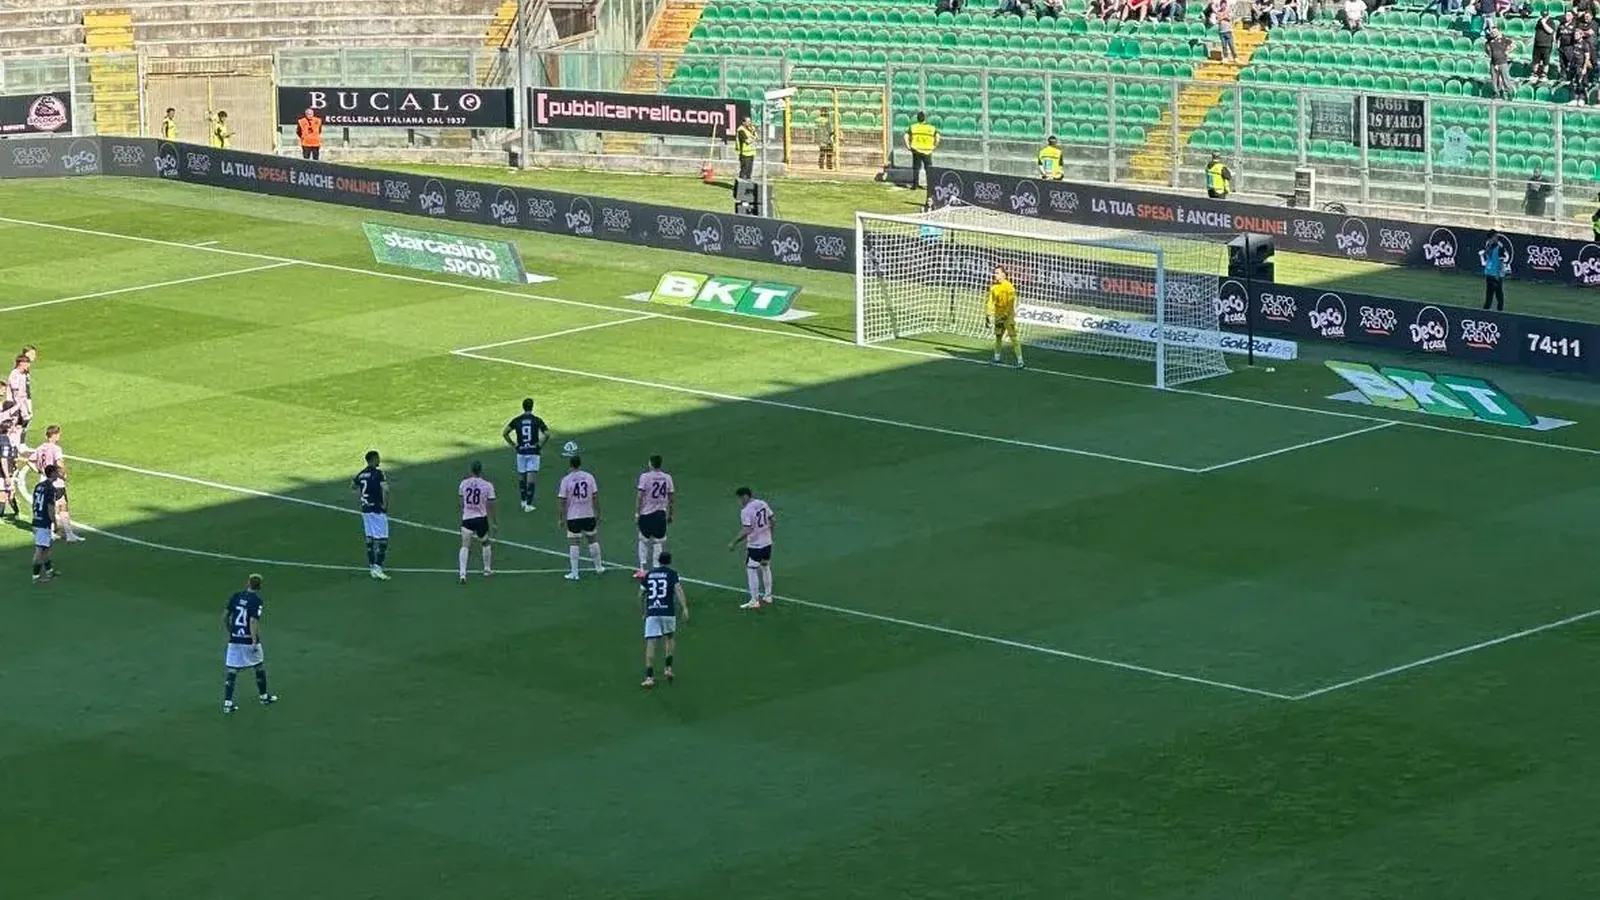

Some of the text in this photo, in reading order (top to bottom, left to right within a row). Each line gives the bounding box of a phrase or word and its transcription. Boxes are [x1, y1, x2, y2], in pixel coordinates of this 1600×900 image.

[309, 91, 481, 112] BUCALO
[325, 115, 466, 125] ECCELLENZA ITALIANA DAL 1937
[1385, 114, 1423, 129] CURVA
[1369, 131, 1422, 148] ULTRA
[12, 147, 49, 157] GRUPPO
[112, 145, 144, 155] GRUPPO
[221, 161, 380, 196] LA TUA SPESA È ANCHE ONLINE!
[1091, 198, 1287, 235] LA TUA SPESA È ANCHE ONLINE!
[1293, 219, 1323, 231] GRUPPO
[1380, 228, 1411, 241] GRUPPO
[383, 232, 497, 261] starcasinò
[1527, 245, 1561, 257] GRUPPO
[1527, 256, 1562, 268] ARENA
[658, 272, 788, 309] BKT
[1260, 293, 1295, 306] GRUPPO
[1260, 303, 1297, 318] ARENA
[1359, 306, 1395, 319] GRUPPO
[1359, 316, 1397, 332] ARENA
[1461, 320, 1498, 332] GRUPPO
[1461, 330, 1500, 345] ARENA
[1527, 334, 1581, 358] 74:11
[1333, 368, 1507, 415] BKT
[521, 425, 532, 442] 9
[360, 479, 370, 497] 2
[465, 487, 481, 505] 28
[573, 481, 588, 499] 43
[652, 481, 667, 499] 24
[756, 507, 767, 528] 27
[647, 579, 668, 599] 33
[235, 605, 248, 627] 21
